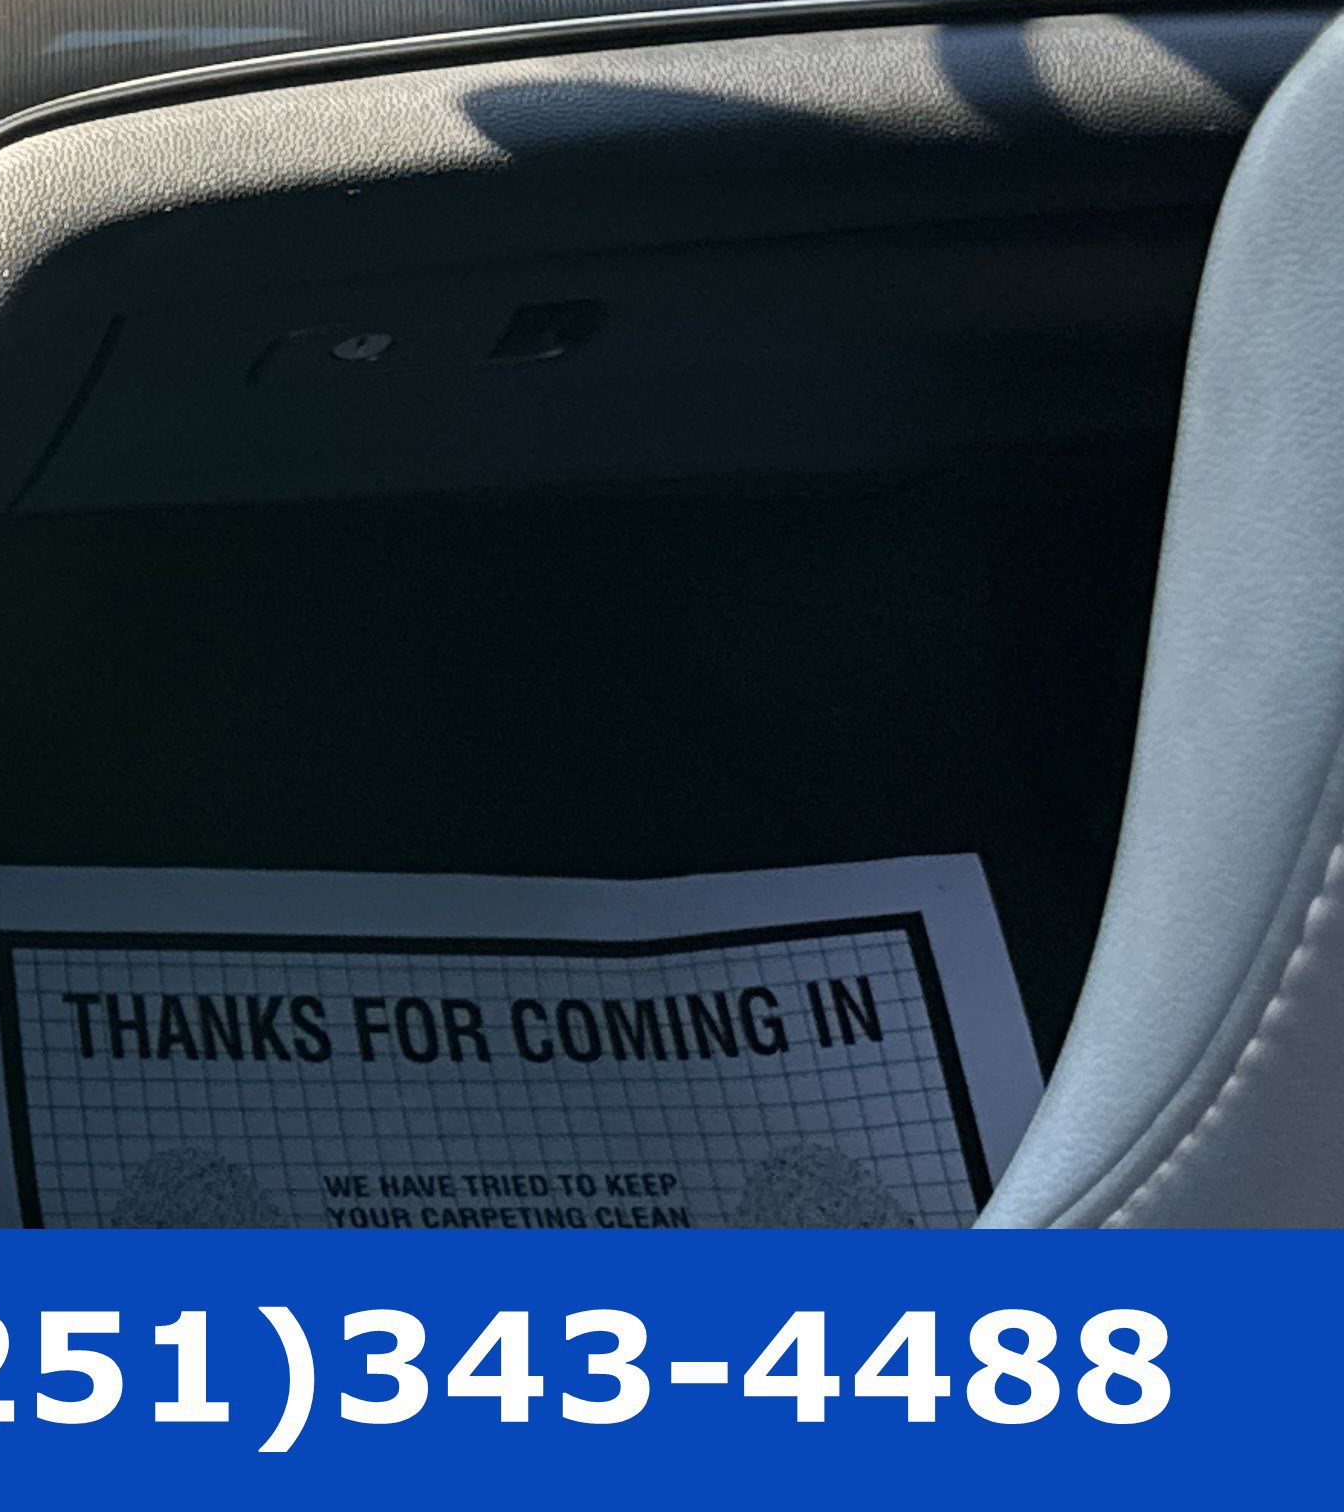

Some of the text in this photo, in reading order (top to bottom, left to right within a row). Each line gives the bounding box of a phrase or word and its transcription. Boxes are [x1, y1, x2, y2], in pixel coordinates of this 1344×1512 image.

[62, 975, 886, 1064] THANKS FOR COMING IN
[323, 1172, 678, 1198] WE HAVE TRIED TO KEEP
[326, 1206, 692, 1229] YOUR CARPETING CLEAN
